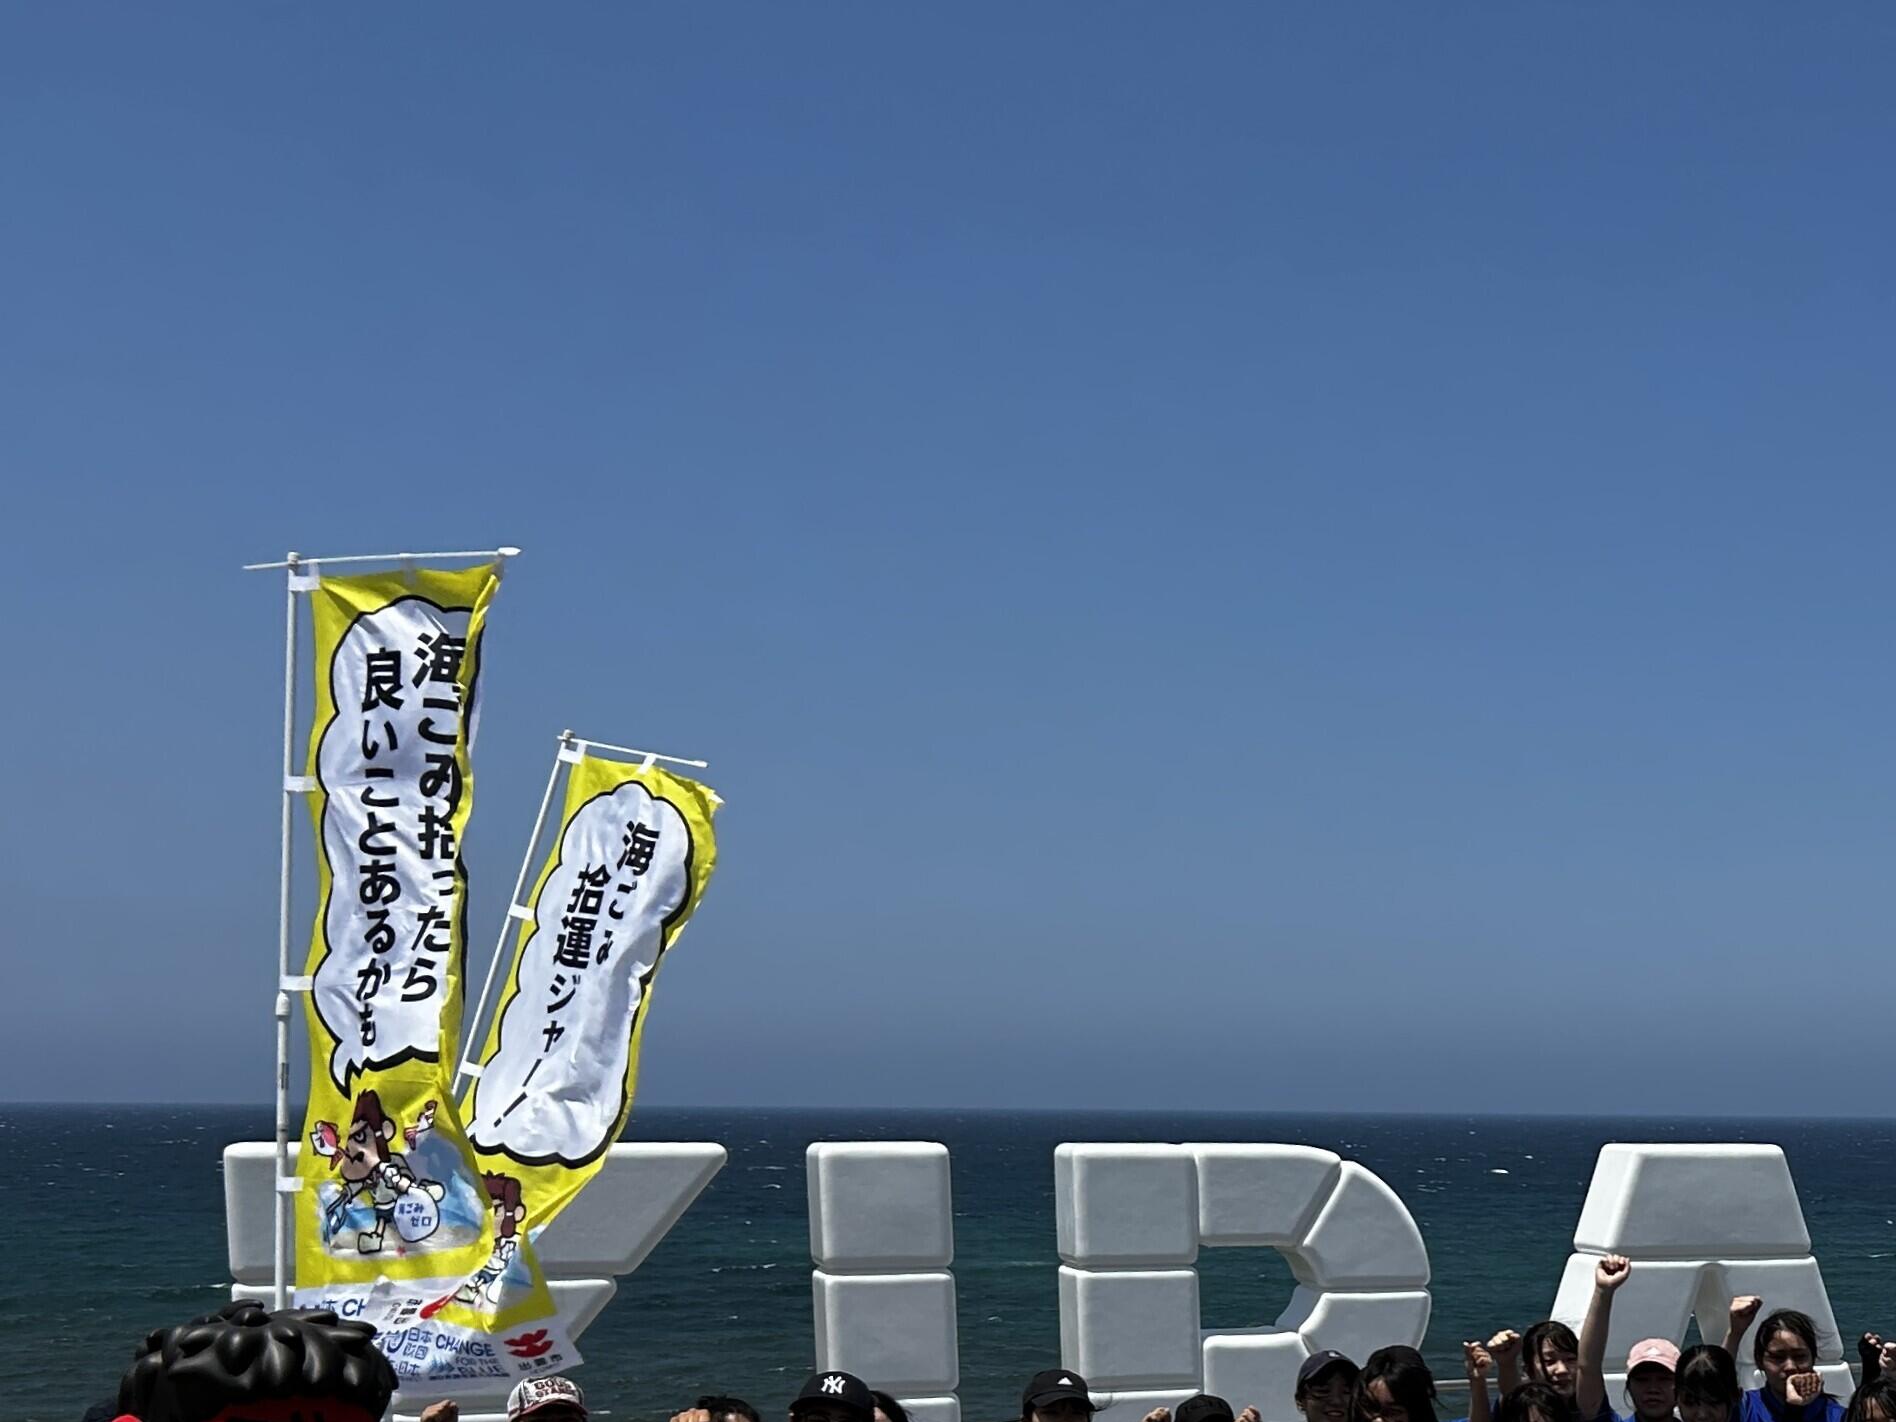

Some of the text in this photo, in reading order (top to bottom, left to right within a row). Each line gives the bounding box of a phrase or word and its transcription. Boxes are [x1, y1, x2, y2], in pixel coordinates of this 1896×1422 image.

[355, 647, 402, 1047] 良いことあるかも
[409, 1327, 433, 1343] 日本
[436, 1333, 496, 1358] CHANGE
